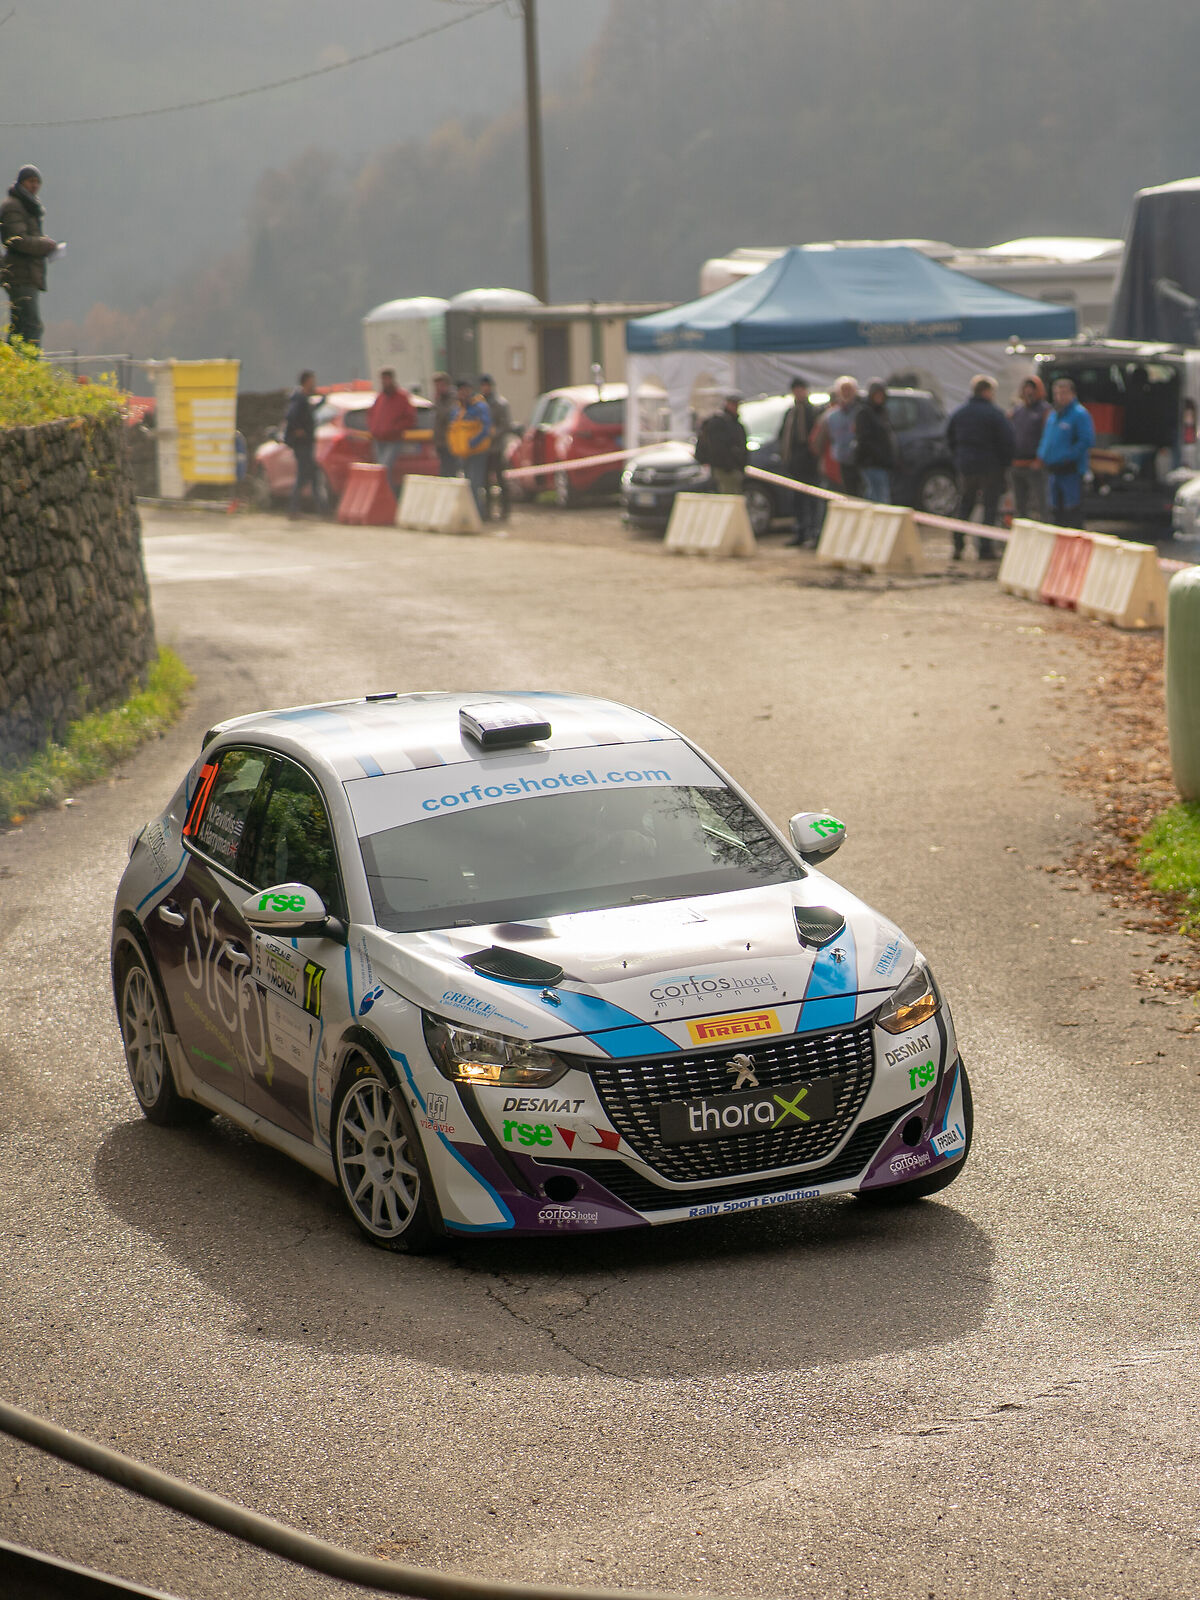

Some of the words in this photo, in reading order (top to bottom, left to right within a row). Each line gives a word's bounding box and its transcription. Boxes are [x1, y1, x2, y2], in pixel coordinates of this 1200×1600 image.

[422, 769, 672, 812] corfoshotel.com
[258, 893, 306, 912] rse
[270, 974, 297, 999] MONZA
[305, 962, 323, 1016] 71
[650, 975, 731, 1001] corfos
[732, 973, 776, 988] hotel
[442, 990, 495, 1014] GREECE
[695, 1014, 772, 1038] PIRELLI
[884, 1035, 932, 1067] DESMAT
[909, 1060, 935, 1091] rse
[502, 1097, 586, 1114] DESMAT
[502, 1119, 553, 1147] rse
[889, 1154, 917, 1172] corfos
[538, 1205, 577, 1219] corfos
[577, 1211, 598, 1220] hotel
[689, 1204, 720, 1218] Rally
[723, 1197, 758, 1214] Sport
[761, 1189, 820, 1206] Evolution
